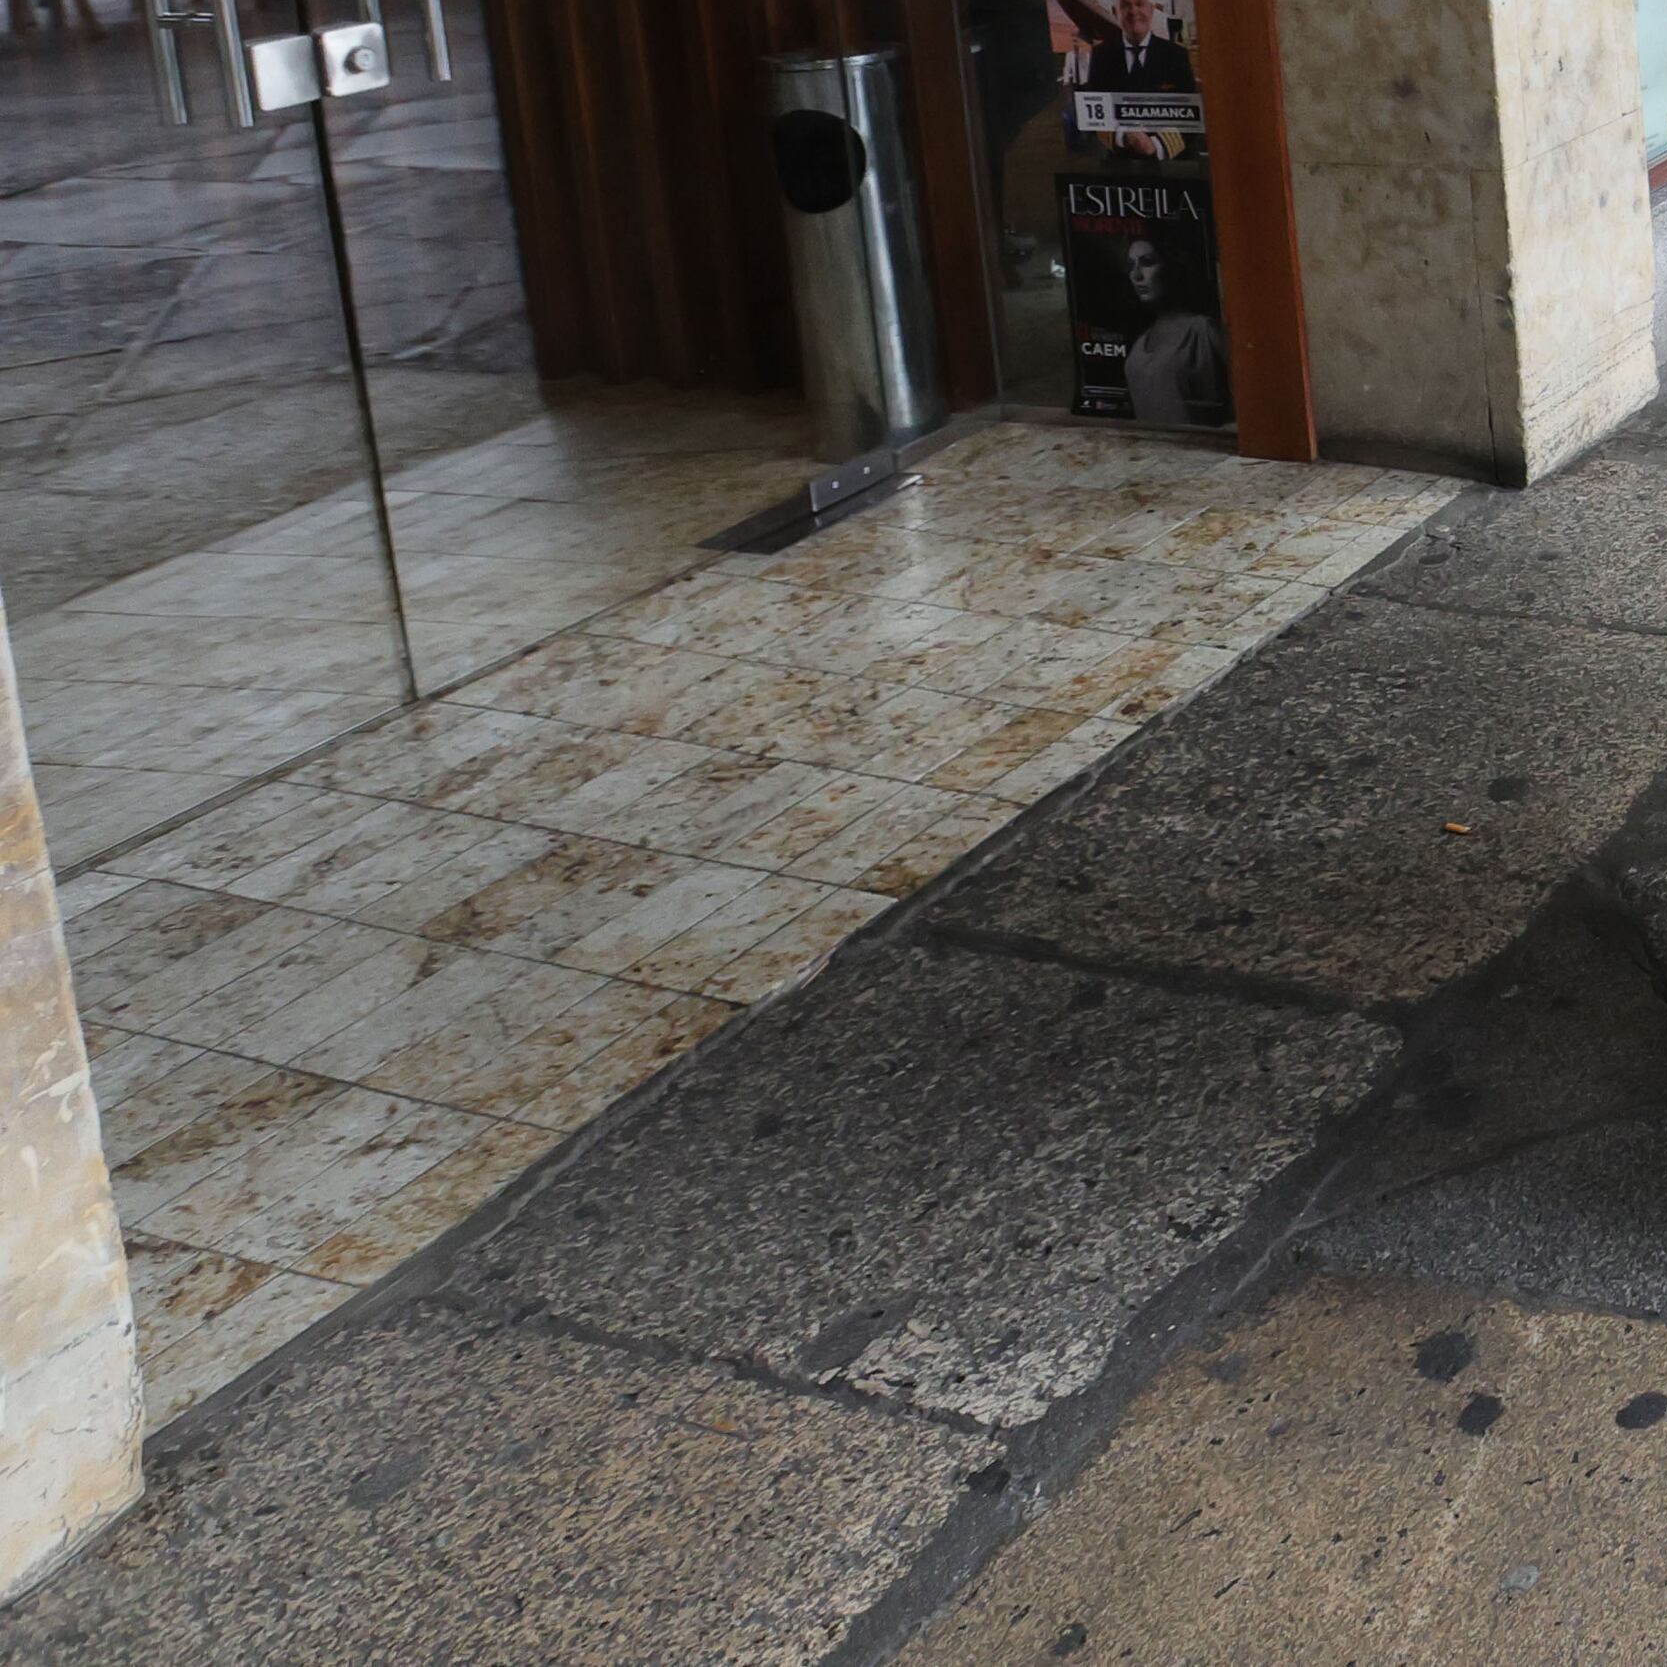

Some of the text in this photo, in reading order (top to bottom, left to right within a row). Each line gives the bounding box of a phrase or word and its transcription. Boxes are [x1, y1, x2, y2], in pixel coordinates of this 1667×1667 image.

[1085, 103, 1105, 120] 18
[1120, 106, 1195, 119] SALAMANCA
[1066, 183, 1204, 220] ESTRELLA
[1081, 341, 1127, 358] CAEM
